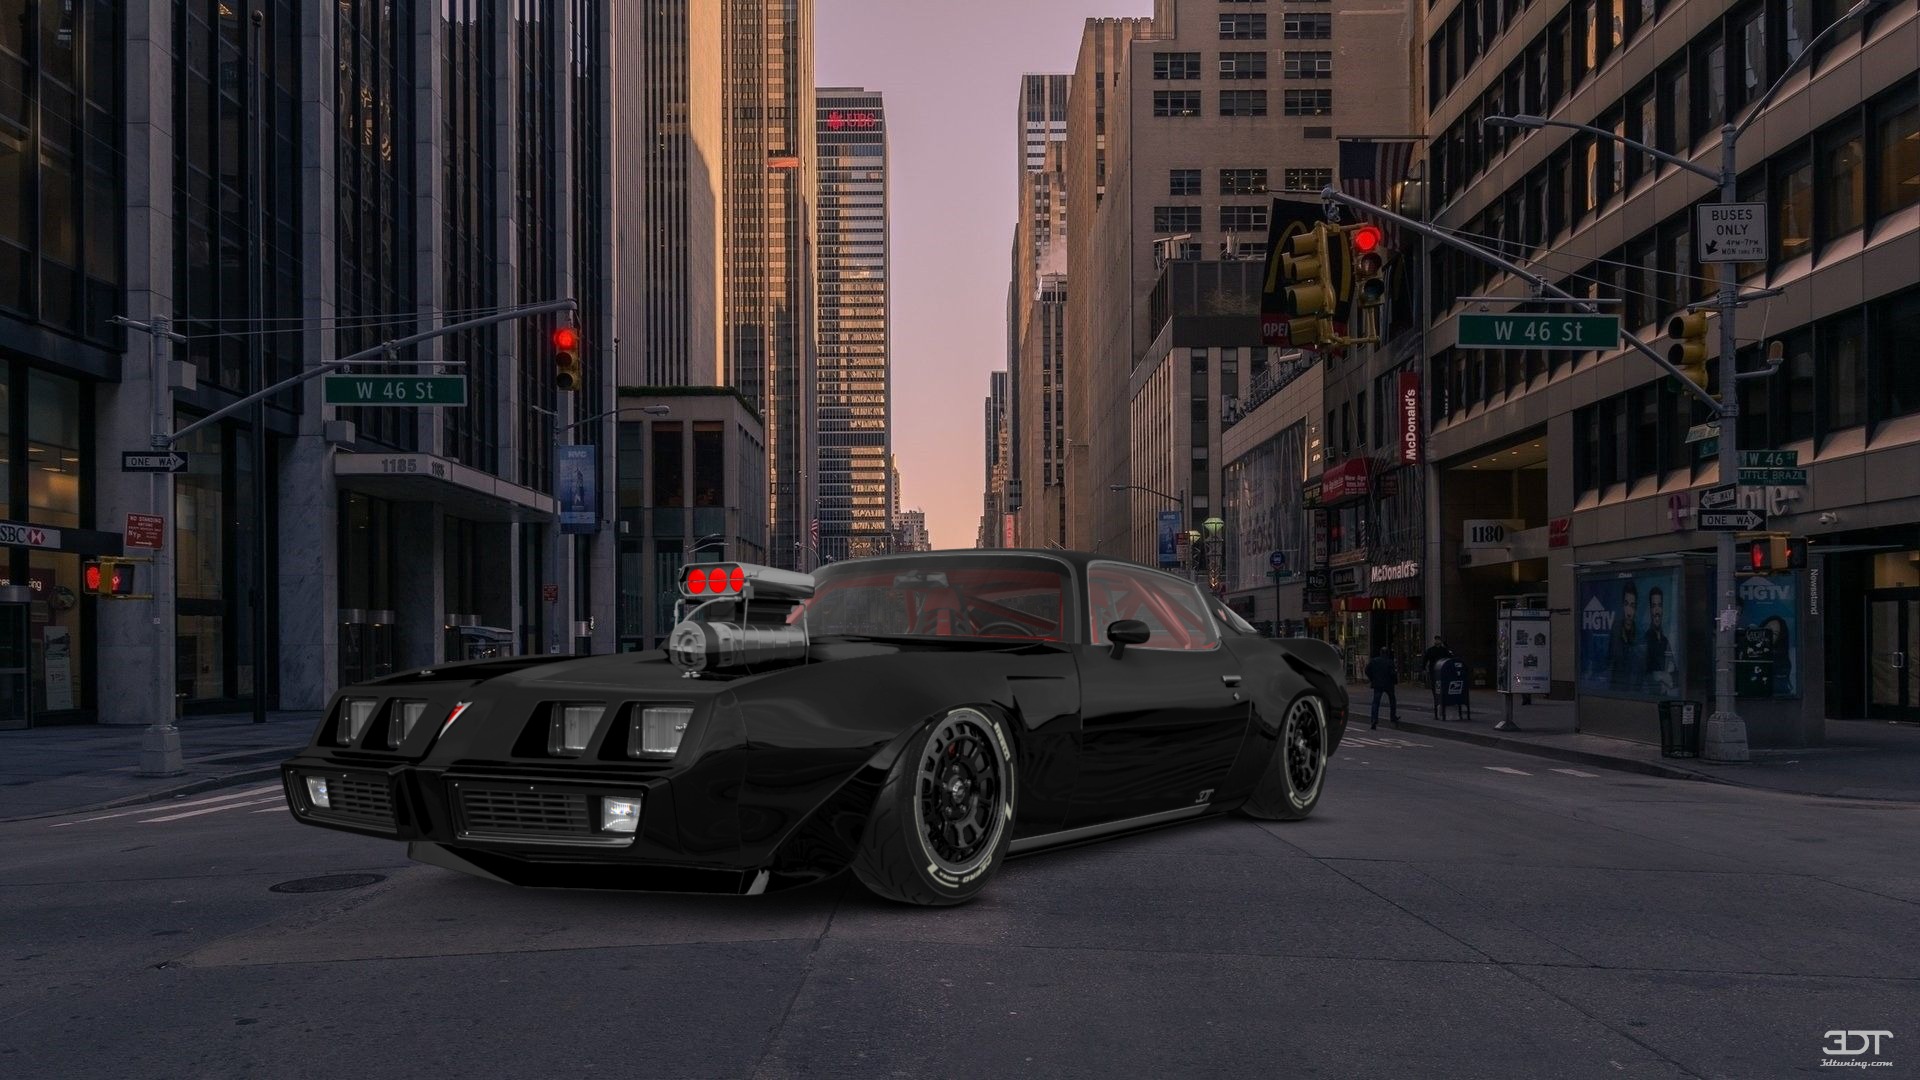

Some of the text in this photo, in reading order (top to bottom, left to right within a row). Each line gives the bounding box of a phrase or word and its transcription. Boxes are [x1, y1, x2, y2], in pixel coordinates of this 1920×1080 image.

[1712, 209, 1753, 221] BUSES
[1716, 224, 1748, 235] ONLY
[1494, 320, 1583, 342] W 46 St
[356, 381, 434, 400] W 46 St
[1405, 389, 1417, 461] McDonald's
[131, 457, 178, 467] ONE WAY
[381, 458, 417, 473] 1185
[1749, 452, 1760, 466] W
[1766, 452, 1784, 466] 46
[1739, 471, 1806, 480] LITTLE BRAZIL
[1708, 516, 1756, 525] ONE WAY
[1471, 525, 1504, 543] 1180
[1371, 559, 1419, 583] McDonald's
[1740, 585, 1790, 600] HGTV
[1810, 568, 1819, 615] Newsstand
[1583, 611, 1615, 631] HGTV
